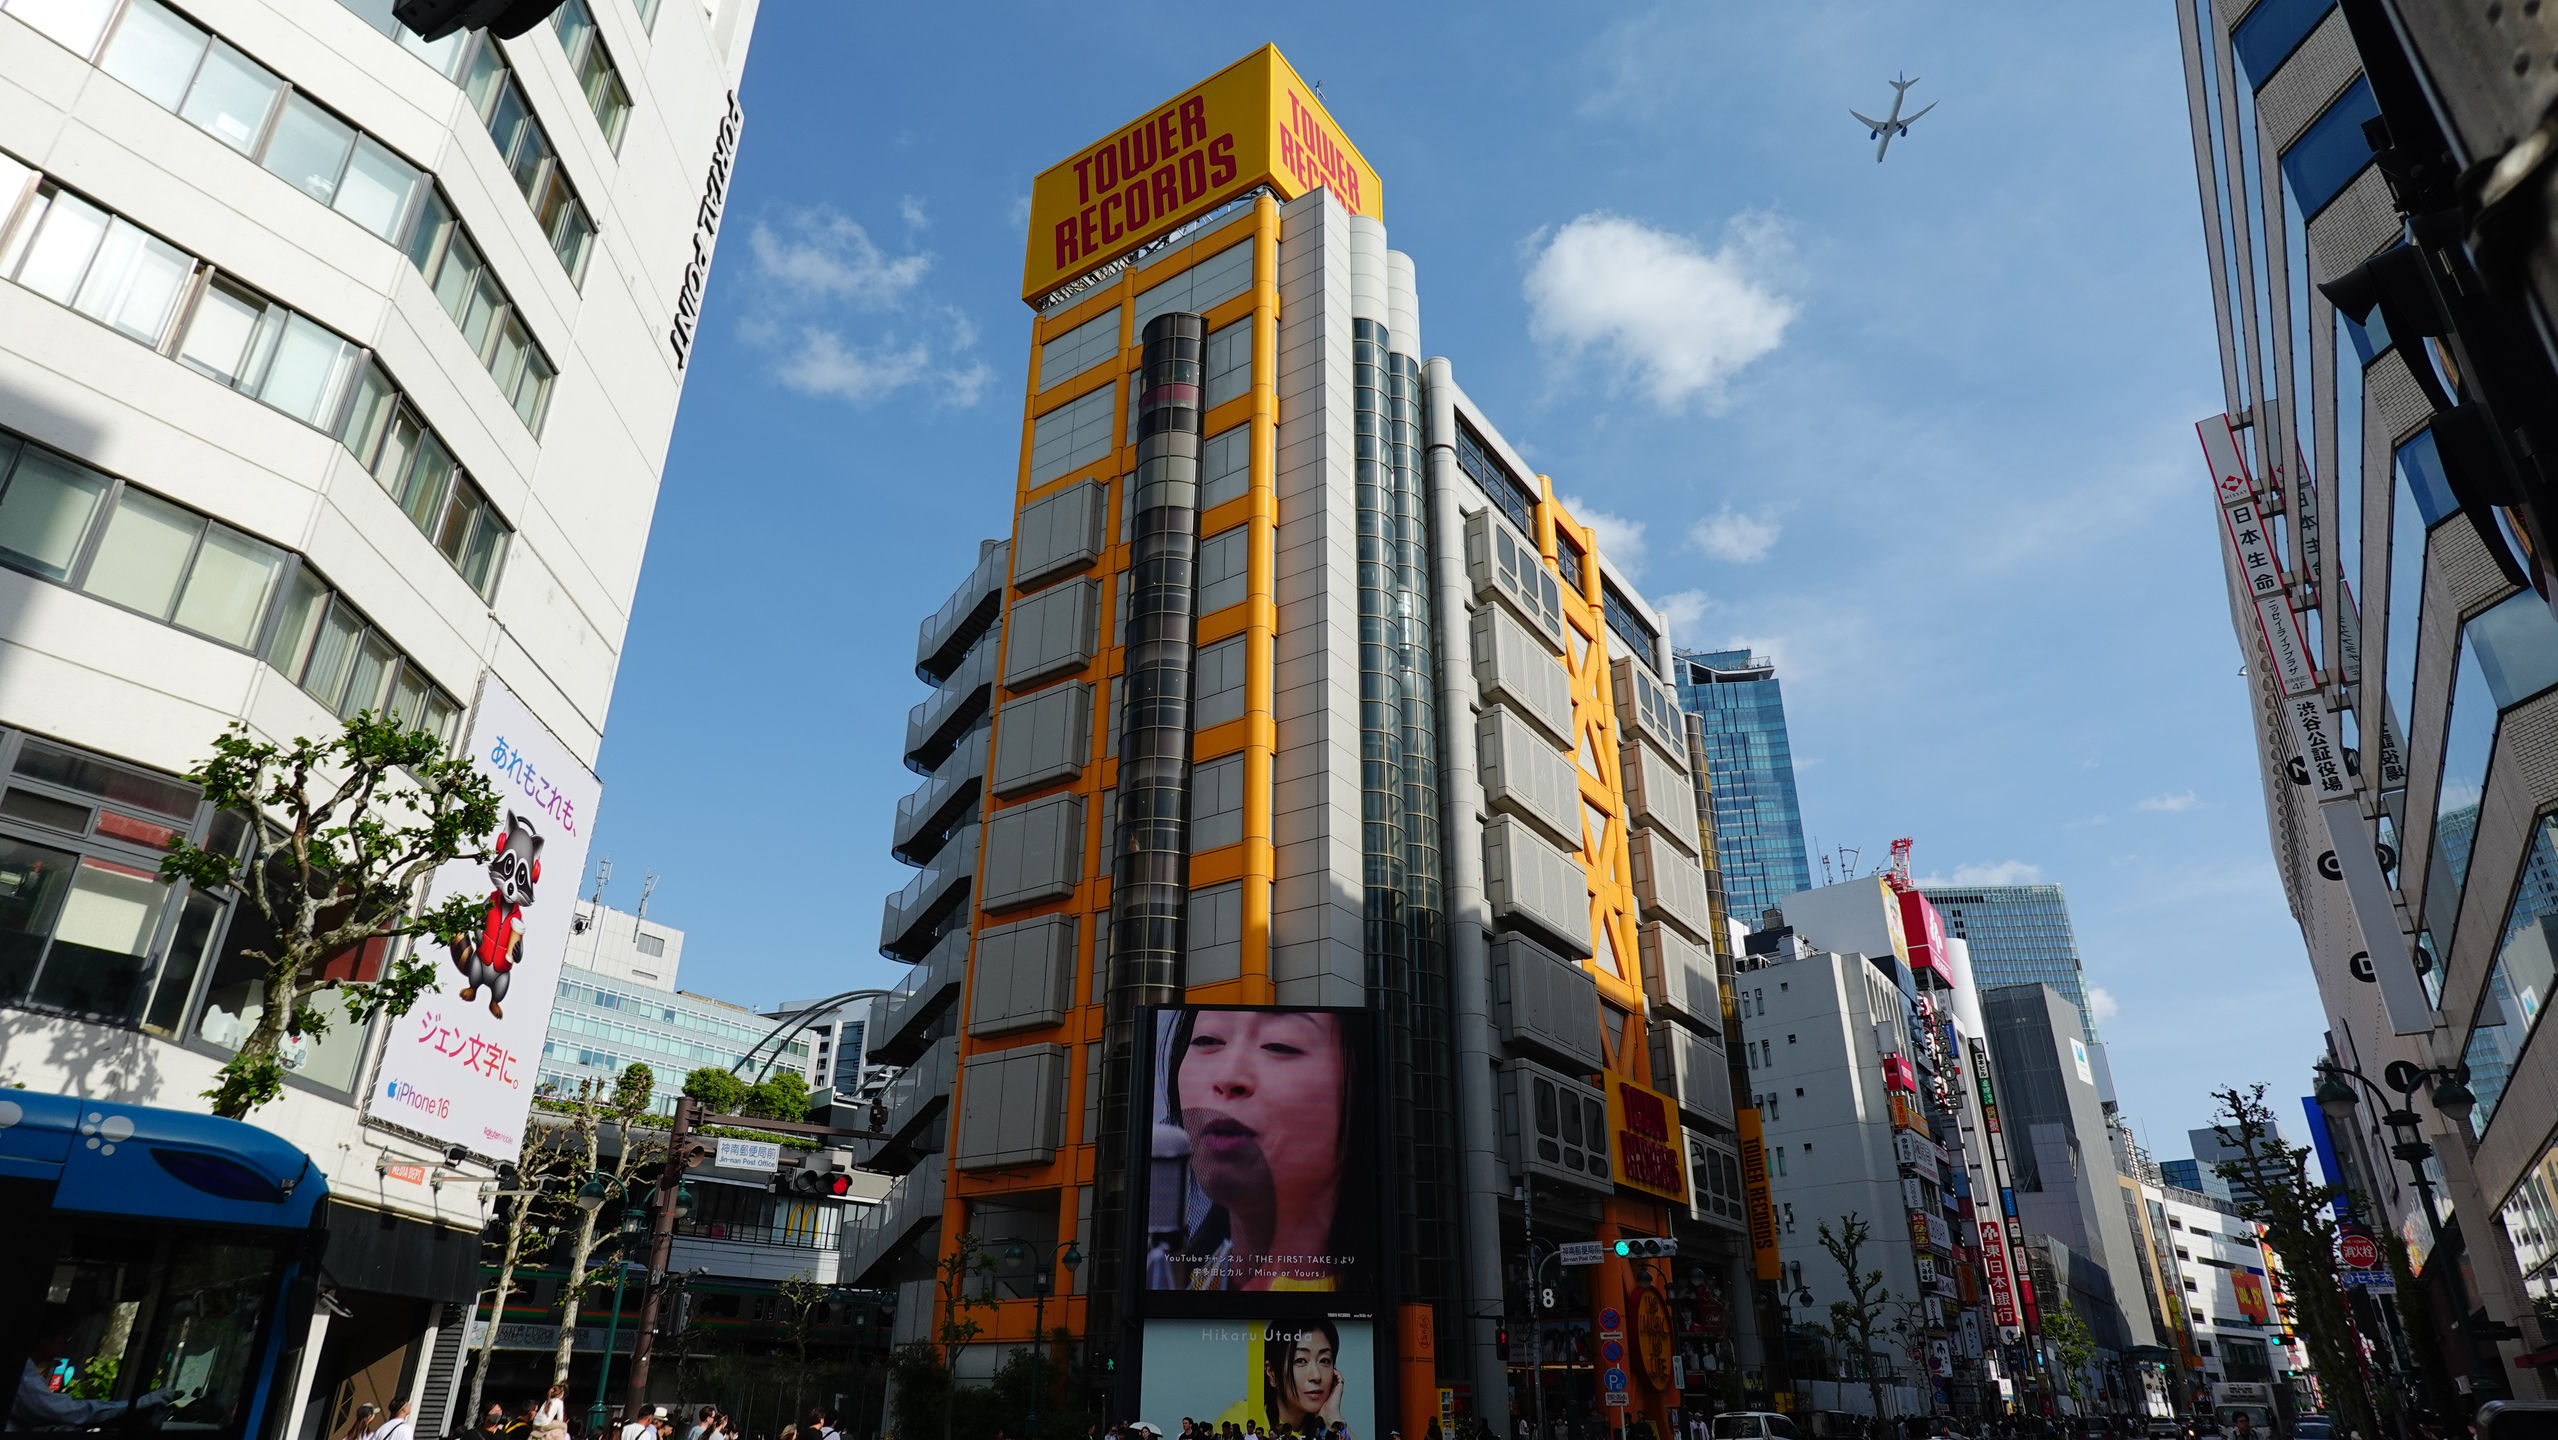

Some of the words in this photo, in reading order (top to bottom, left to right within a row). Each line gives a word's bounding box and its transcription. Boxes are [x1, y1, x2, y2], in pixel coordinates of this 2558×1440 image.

[697, 88, 744, 237] PORTAL
[1073, 95, 1207, 206] TOWER
[1288, 88, 1360, 211] TOWER
[1055, 133, 1238, 271] RECORDS
[669, 232, 709, 371] POINT
[2224, 489, 2247, 500] NISSAY
[2233, 506, 2275, 591] 日本生命
[2292, 680, 2307, 690] 4F
[2297, 701, 2343, 792] 渋谷公証役場
[490, 735, 578, 838] あれもこれも、
[418, 1010, 520, 1091] ジェン文字に。
[396, 1081, 436, 1115] iPhone
[437, 1097, 450, 1119] 16
[483, 1126, 500, 1142] Rakuten
[721, 1143, 776, 1159] 神南郵便局前
[719, 1155, 742, 1165] Jin-nan
[742, 1157, 756, 1167] Post
[757, 1159, 776, 1168] Office
[1742, 1136, 1765, 1184] TOWER
[1750, 1189, 1774, 1250] RECORDS
[1193, 1268, 1244, 1278] 宇多田ヒカル
[1276, 1254, 1304, 1264] FIRST
[2343, 1245, 2374, 1258] 消火栓
[1542, 1288, 1555, 1308] 8
[1984, 1243, 2014, 1322] 東日本銀行
[1201, 1328, 1257, 1342] Hikaru
[1263, 1328, 1313, 1343] Utada
